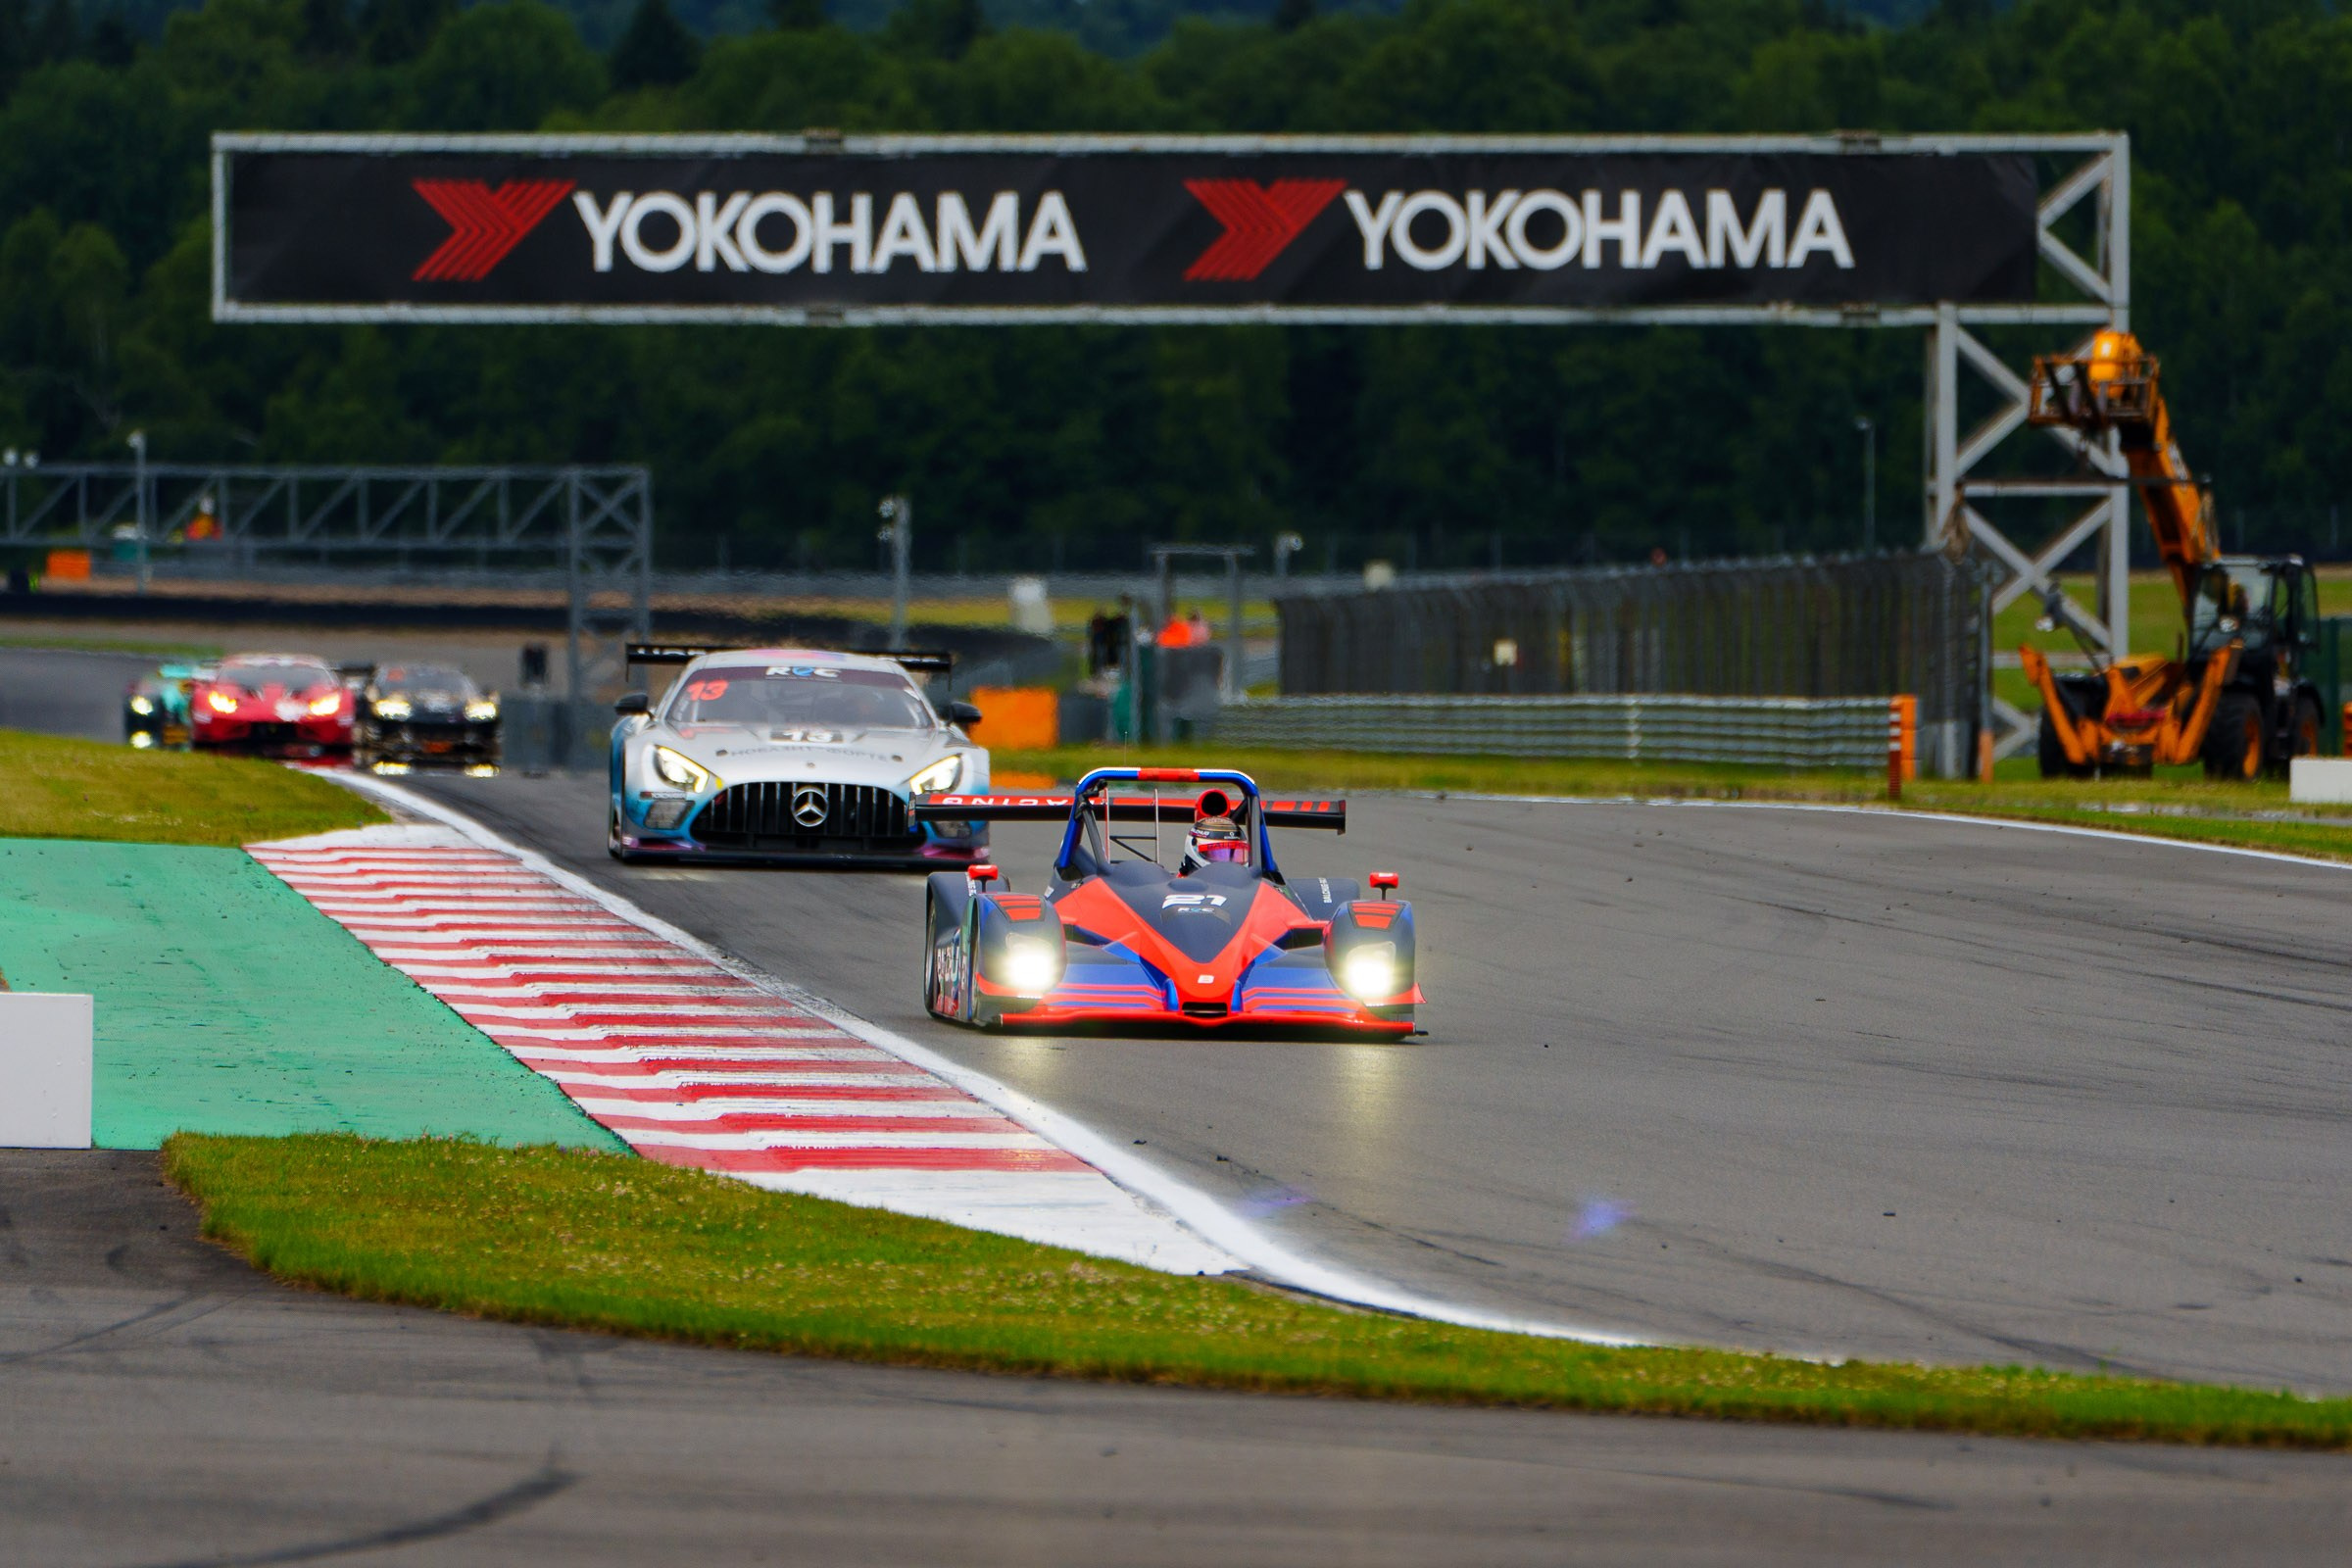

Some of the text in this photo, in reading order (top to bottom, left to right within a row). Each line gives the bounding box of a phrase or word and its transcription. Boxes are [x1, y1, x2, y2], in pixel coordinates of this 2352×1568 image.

[574, 191, 1087, 273] YOKOHAMA
[1344, 189, 1854, 270] YOKOHAMA
[686, 679, 729, 701] 13
[782, 729, 833, 743] 13
[1161, 893, 1227, 909] 21
